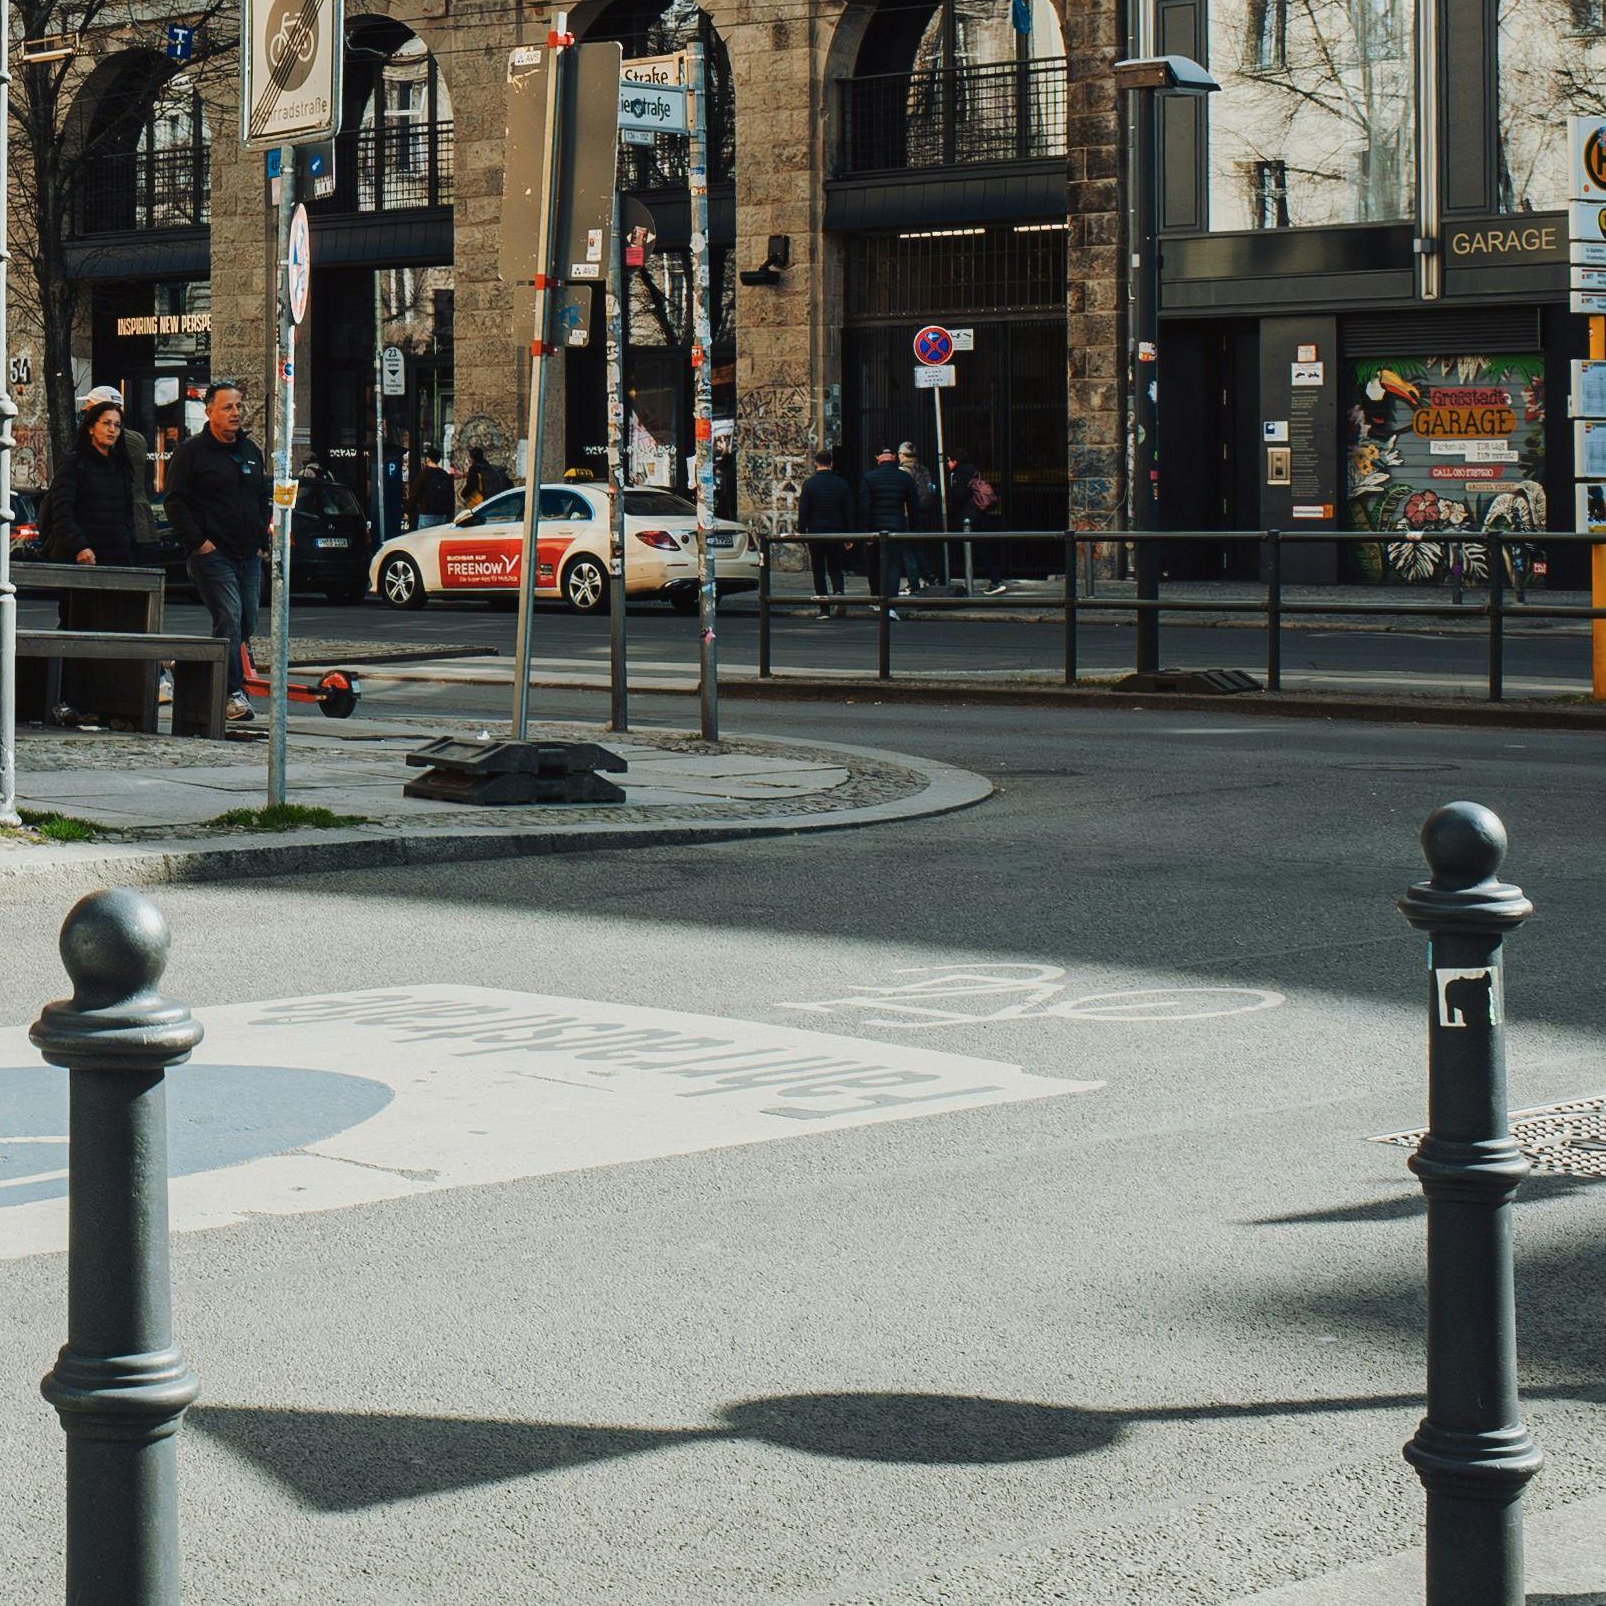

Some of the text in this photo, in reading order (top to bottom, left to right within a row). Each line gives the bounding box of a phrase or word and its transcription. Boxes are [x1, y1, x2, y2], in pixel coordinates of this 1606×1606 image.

[624, 66, 669, 85] Straße
[262, 97, 328, 124] rradstraße
[1452, 228, 1557, 255] GARAGE
[117, 313, 212, 336] INSPIRING NEW PERSPE
[9, 357, 29, 384] 54
[1415, 409, 1513, 436] GARAGE
[389, 462, 396, 476] P
[1432, 468, 1452, 477] CALL
[447, 562, 503, 576] FREENOW
[247, 995, 1005, 1120] Fahrradstraße
